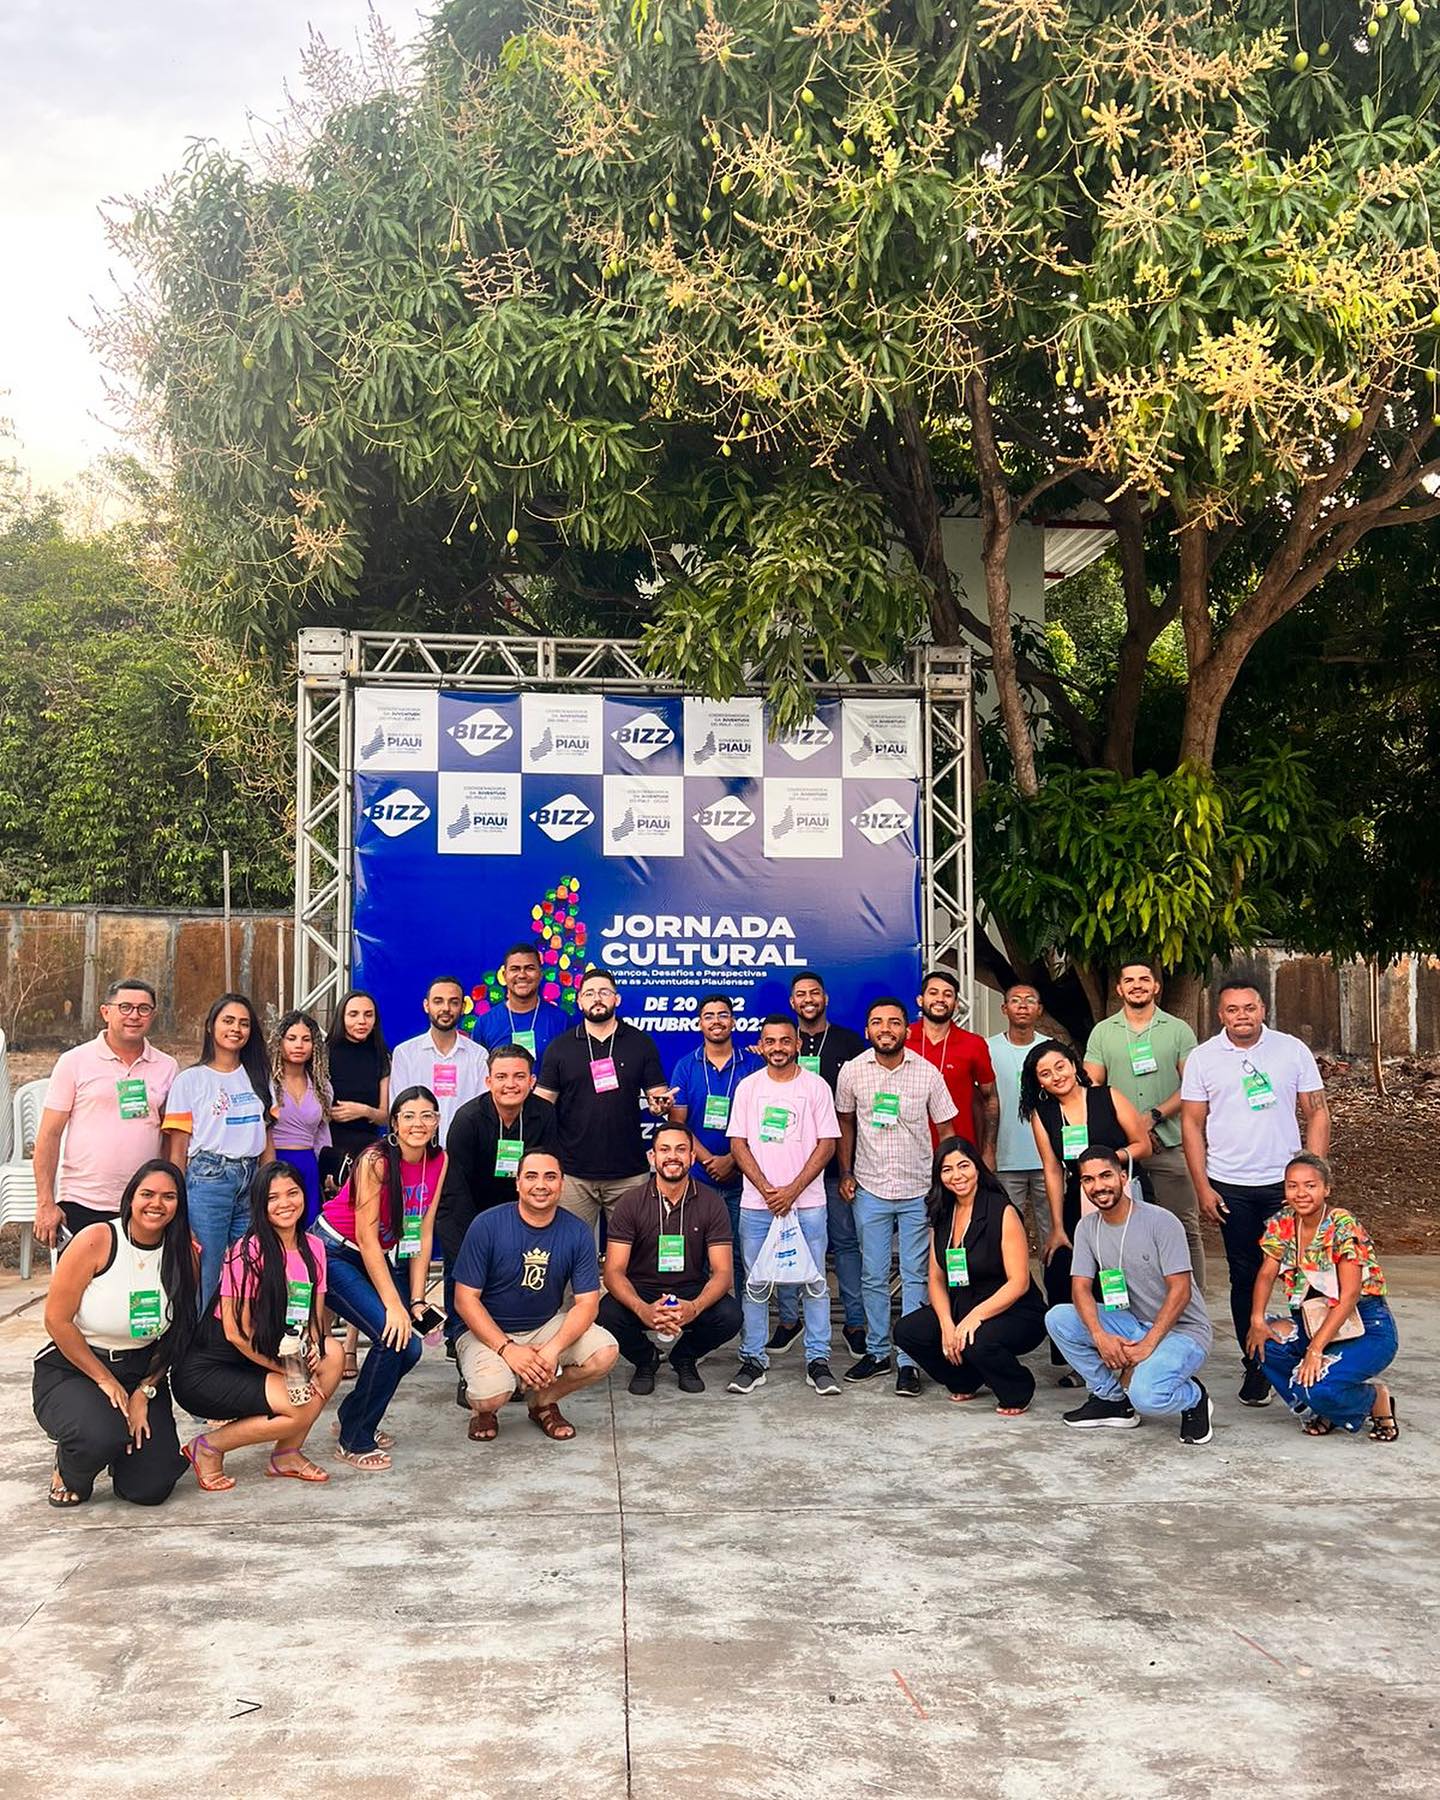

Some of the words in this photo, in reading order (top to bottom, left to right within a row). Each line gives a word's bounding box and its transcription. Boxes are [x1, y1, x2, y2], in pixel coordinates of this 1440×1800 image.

[453, 724, 509, 740] BIZZ
[616, 728, 671, 744] BIZZ
[370, 805, 426, 821] BIZZ
[536, 809, 590, 825] BIZZ
[699, 810, 752, 826] BIZZ
[856, 813, 909, 829] BIZZ
[601, 915, 796, 938] JORNADA
[601, 942, 808, 966] CULTURAL
[651, 969, 694, 977] Desafios
[703, 969, 768, 978] Perspectivas
[642, 978, 700, 986] Juventudes
[701, 978, 755, 986] Piauienses
[644, 997, 669, 1011] DE
[672, 997, 698, 1012] 20
